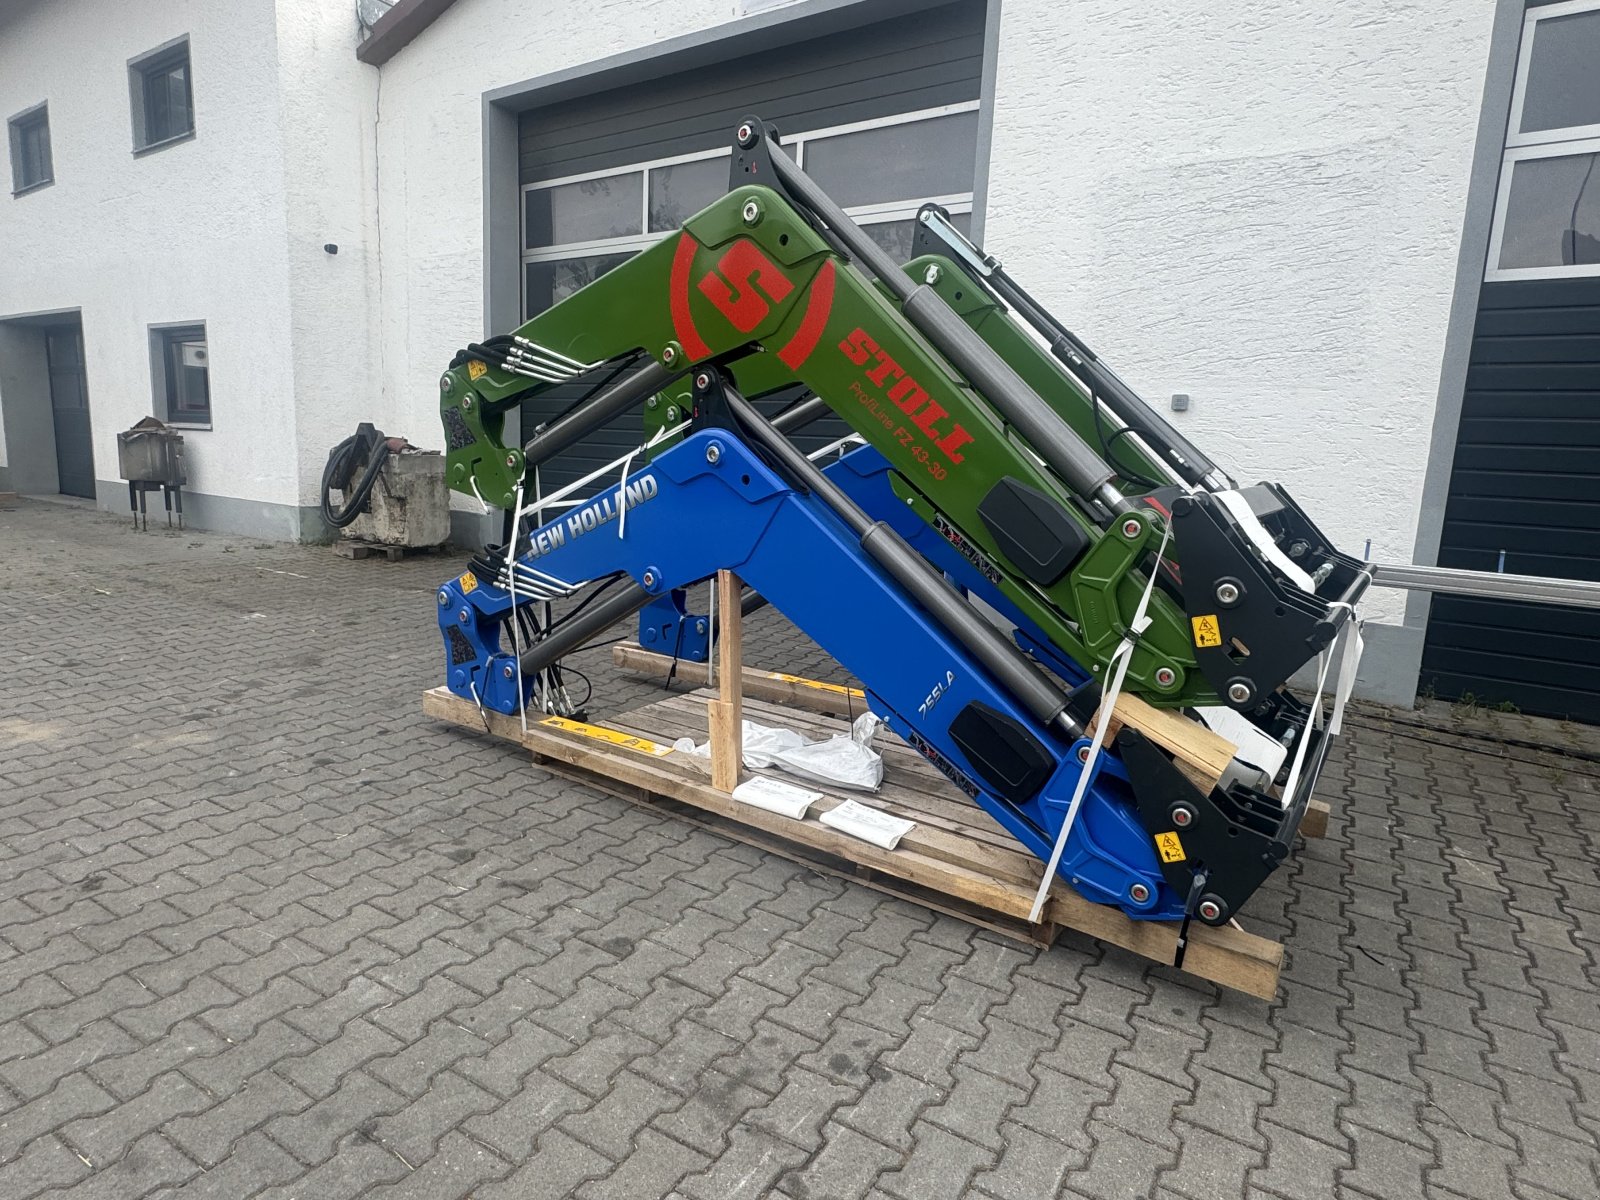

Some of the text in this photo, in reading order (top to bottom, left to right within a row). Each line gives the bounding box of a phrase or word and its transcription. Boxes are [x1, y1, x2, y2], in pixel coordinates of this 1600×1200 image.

[838, 327, 975, 464] STOLL
[848, 381, 947, 480] ProfiLine FZ 43-30
[566, 474, 658, 539] HOLLAND
[918, 670, 955, 720] 755LA
